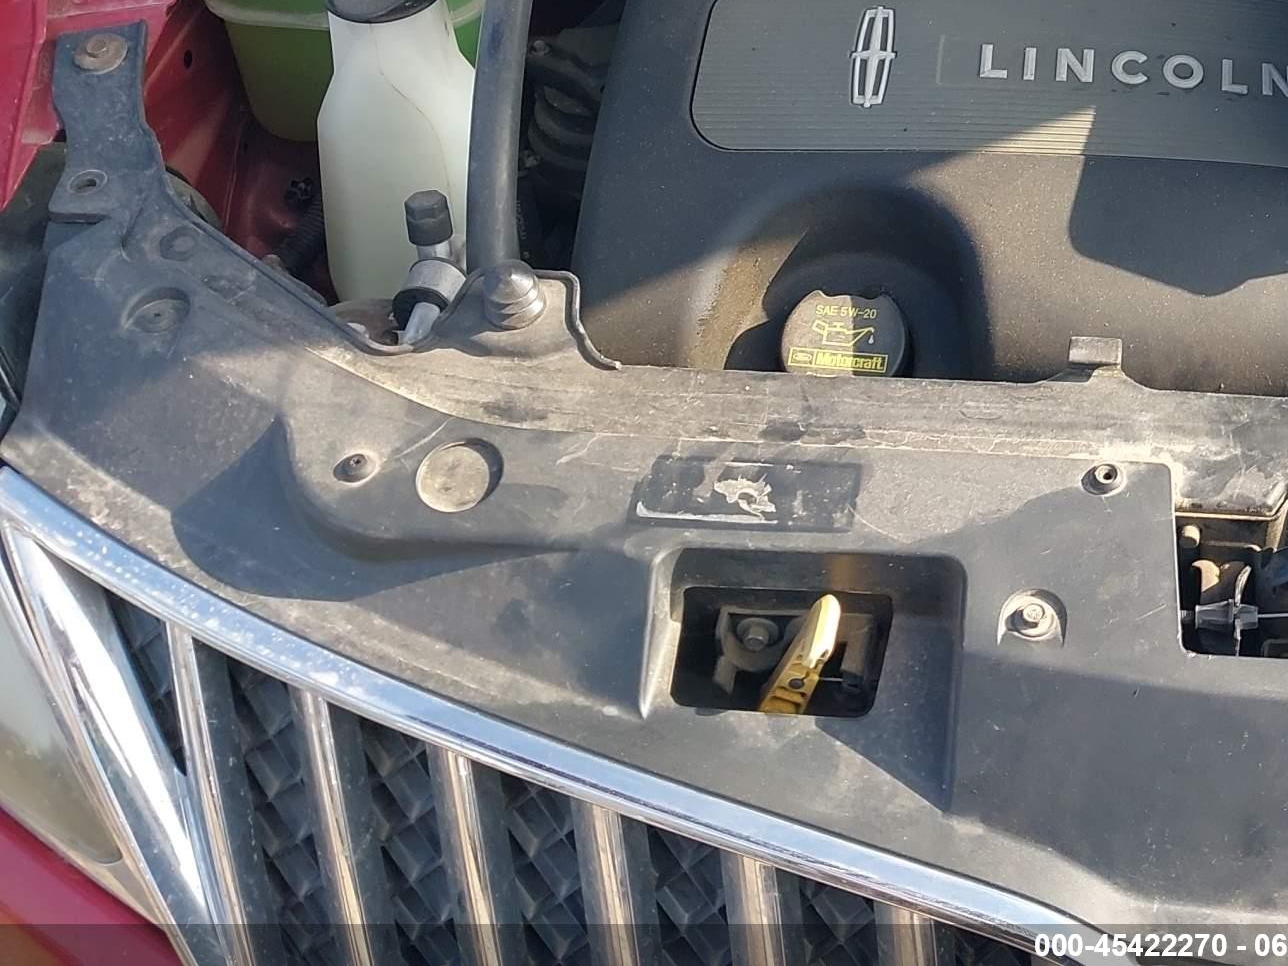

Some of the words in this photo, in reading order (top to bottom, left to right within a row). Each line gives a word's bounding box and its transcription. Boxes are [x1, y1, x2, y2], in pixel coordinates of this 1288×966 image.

[815, 304, 839, 316] SAE
[839, 306, 877, 319] 5W-20
[815, 351, 884, 370] Motorcraft
